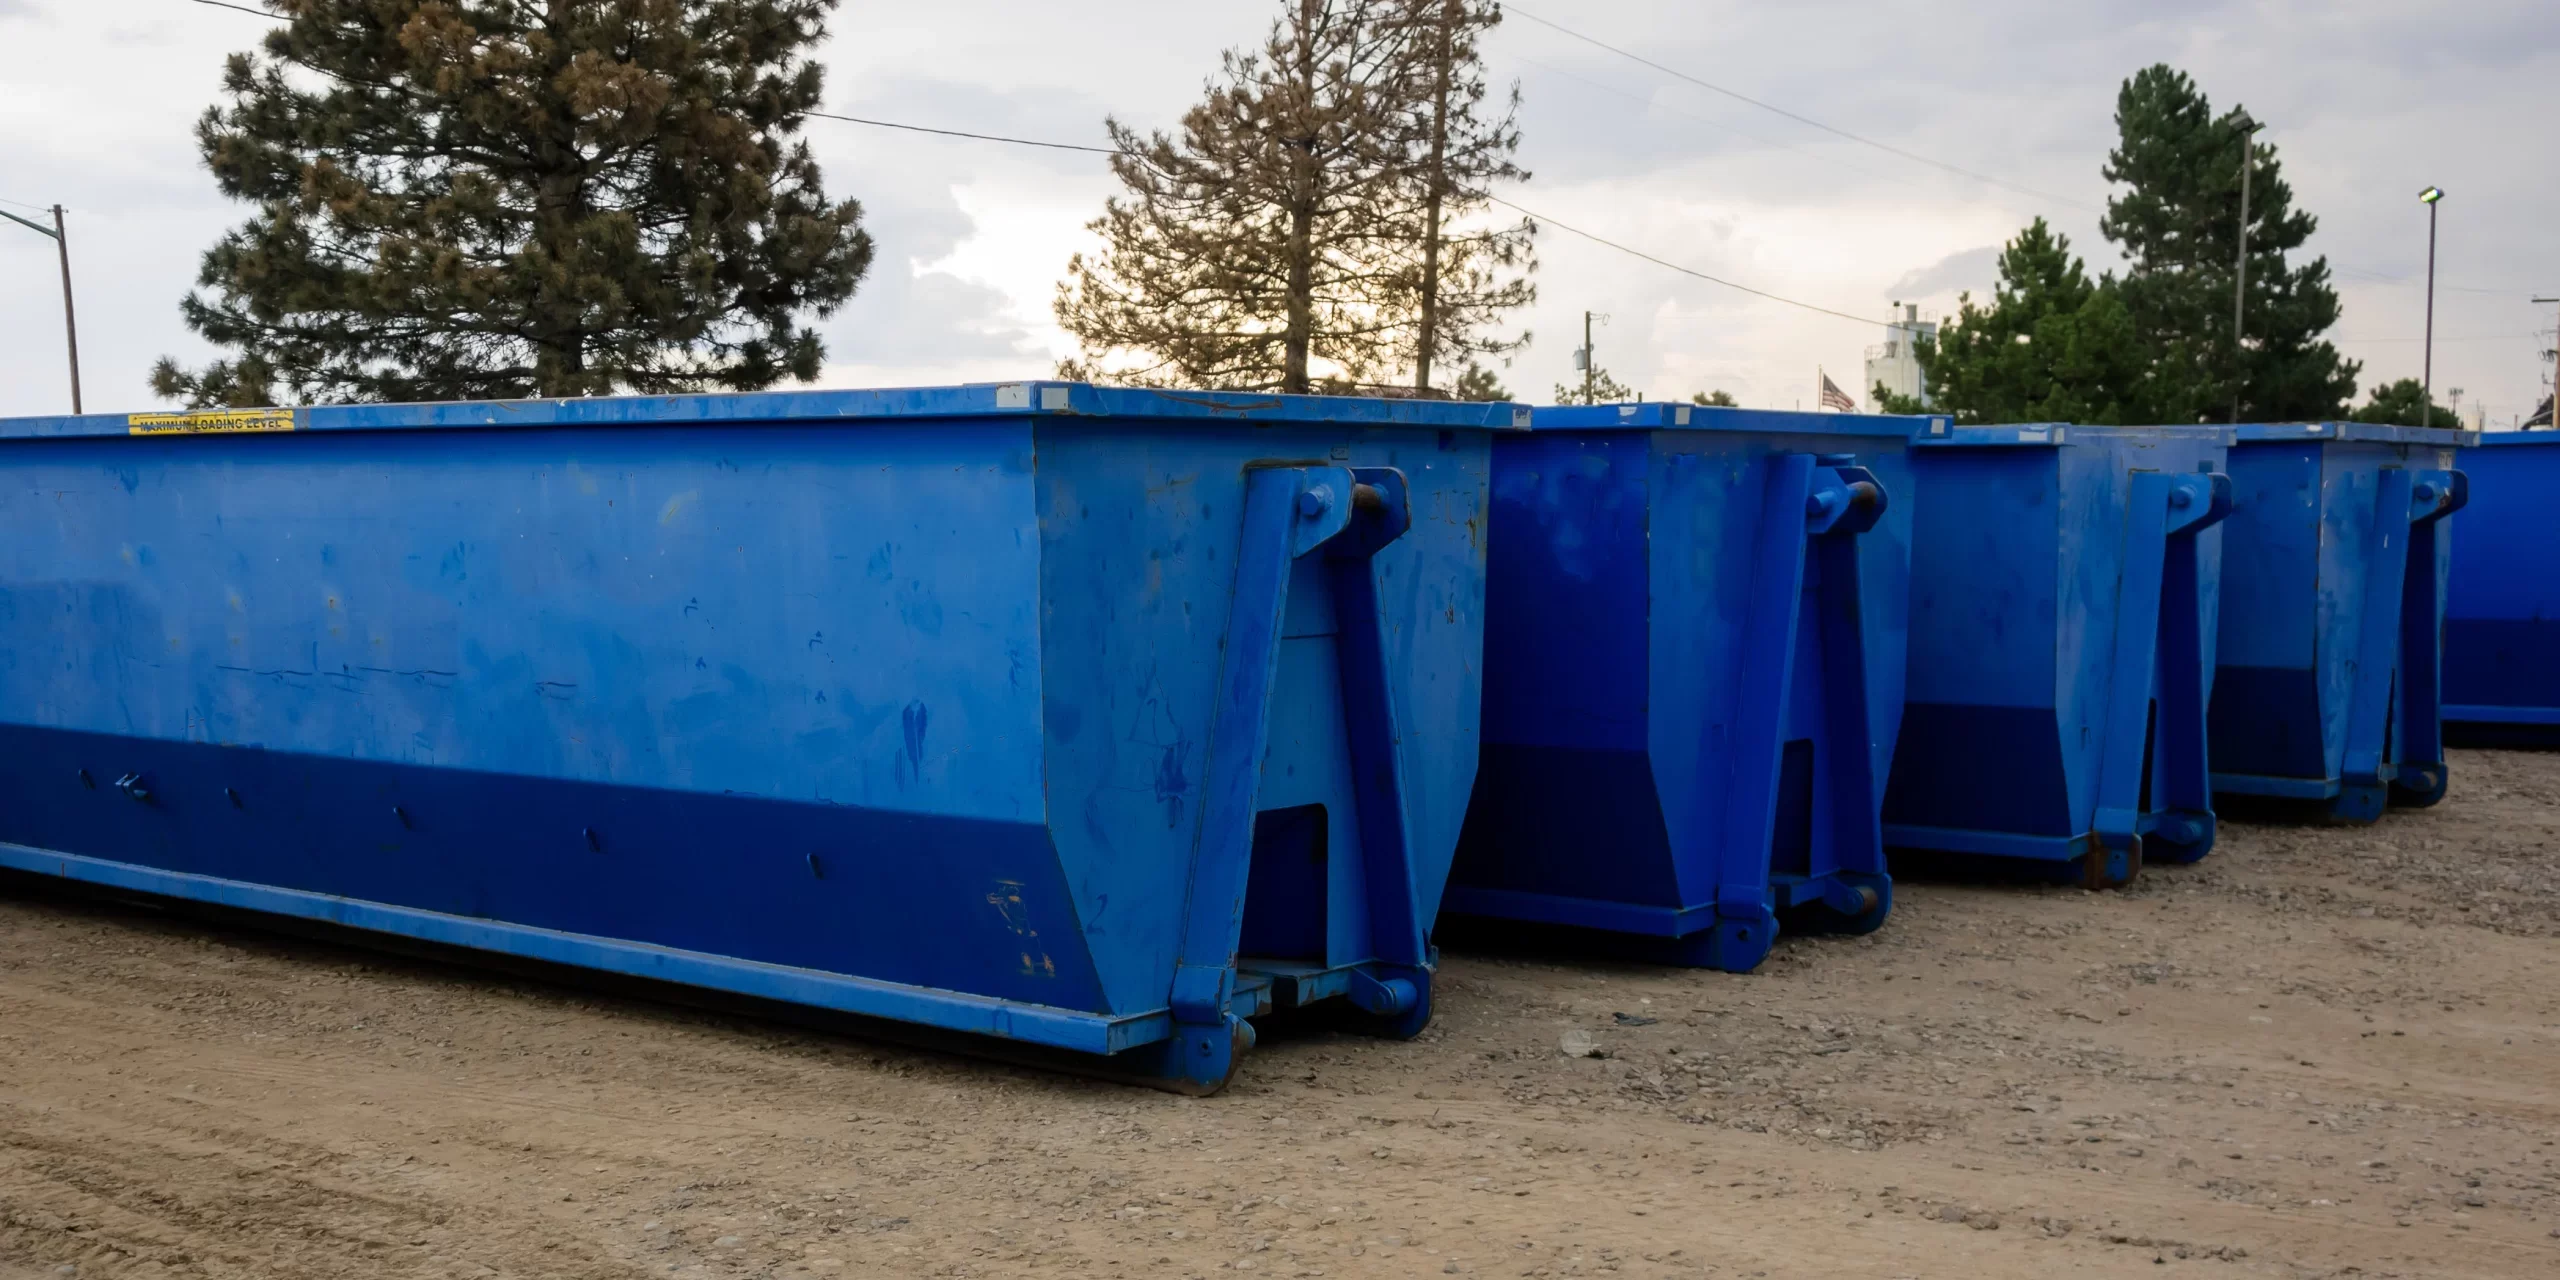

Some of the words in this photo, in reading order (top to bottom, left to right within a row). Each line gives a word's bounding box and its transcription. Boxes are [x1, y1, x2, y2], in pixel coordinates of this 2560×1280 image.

[140, 420, 191, 432] MAXIMUM
[194, 418, 243, 430] LOADING
[246, 417, 282, 429] LEVEL
